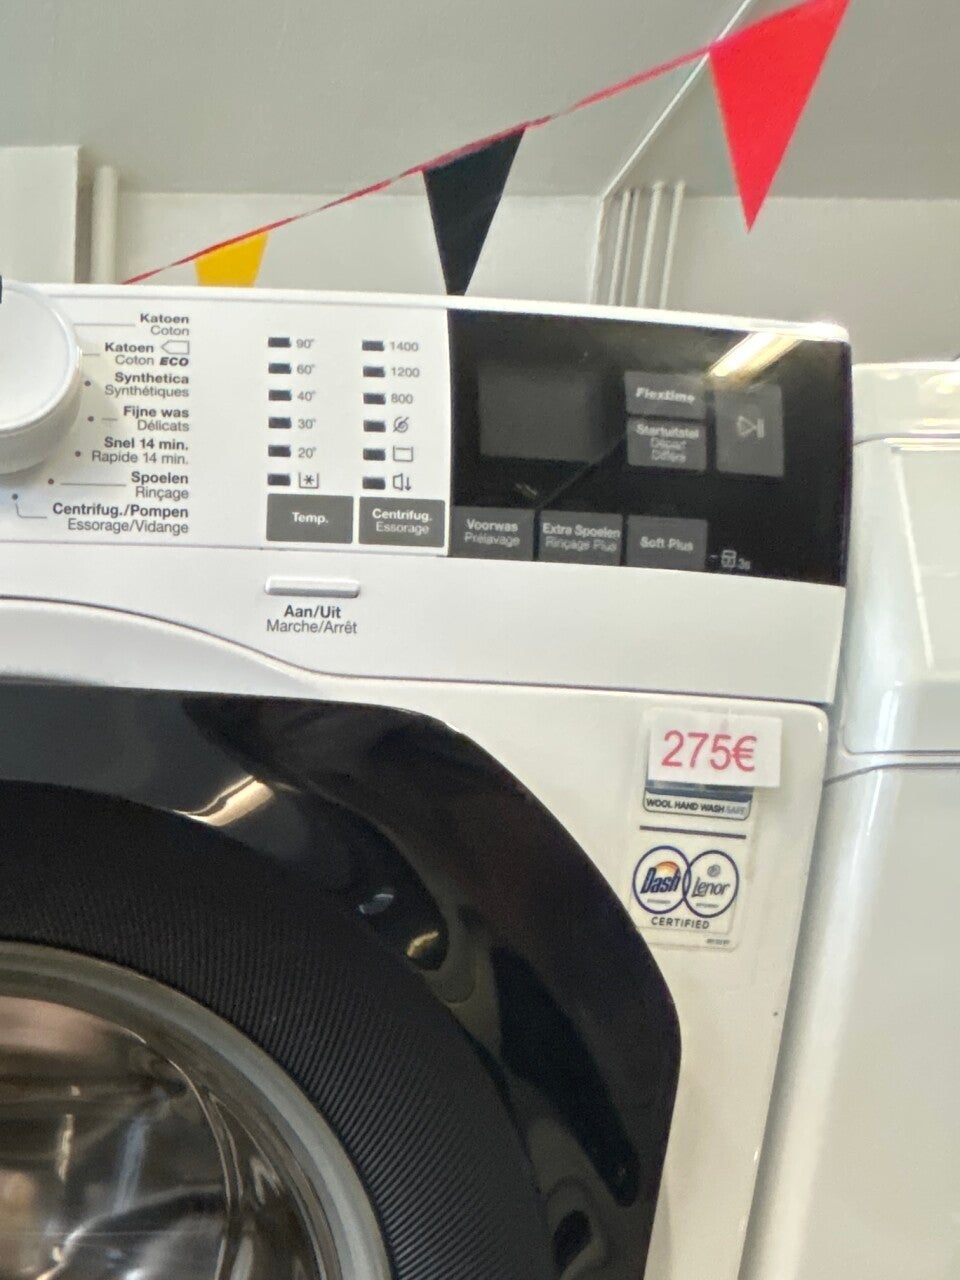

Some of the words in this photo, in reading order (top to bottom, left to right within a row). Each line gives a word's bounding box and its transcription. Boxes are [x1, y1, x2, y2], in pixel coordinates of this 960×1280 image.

[140, 313, 189, 324] Katoen
[150, 325, 190, 336] Coton
[104, 342, 154, 353] Katoen
[390, 341, 419, 352] 1400
[115, 354, 154, 366] Coton
[159, 356, 189, 367] ECO
[114, 372, 189, 385] Synthetica
[390, 367, 421, 378] 1200
[105, 385, 190, 399] Synthétiques
[391, 393, 414, 404] 800
[123, 405, 157, 419] Fijne
[161, 408, 189, 418] was
[137, 419, 190, 432] Délicats
[104, 436, 135, 449] Snel
[140, 437, 155, 450] 14
[159, 438, 189, 451] min.
[91, 450, 138, 464] Rapide
[143, 451, 157, 464] 14
[161, 452, 189, 465] min.
[131, 471, 189, 487] Spoelen
[135, 486, 189, 502] Rinçage
[52, 502, 189, 520] Centrifug./Pompen
[372, 508, 432, 523] Centrifug.
[292, 512, 329, 526] Temp.
[466, 518, 519, 532] Voorwas
[68, 518, 190, 536] Essorage/Vidange
[375, 522, 430, 535] Essorage
[542, 522, 572, 535] Extra
[574, 524, 621, 540] Spoelen
[640, 536, 666, 549] Soft
[668, 538, 694, 553] Plus
[283, 604, 342, 619] Aan/Uit
[266, 618, 358, 634] Marche/Arrêt
[661, 730, 758, 772] 275€
[646, 798, 673, 809] WOOL
[674, 801, 699, 811] HAND
[701, 803, 724, 814] WASH
[640, 866, 681, 895] Dash
[691, 876, 731, 898] Lenor
[651, 916, 710, 930] CERTIFIED
